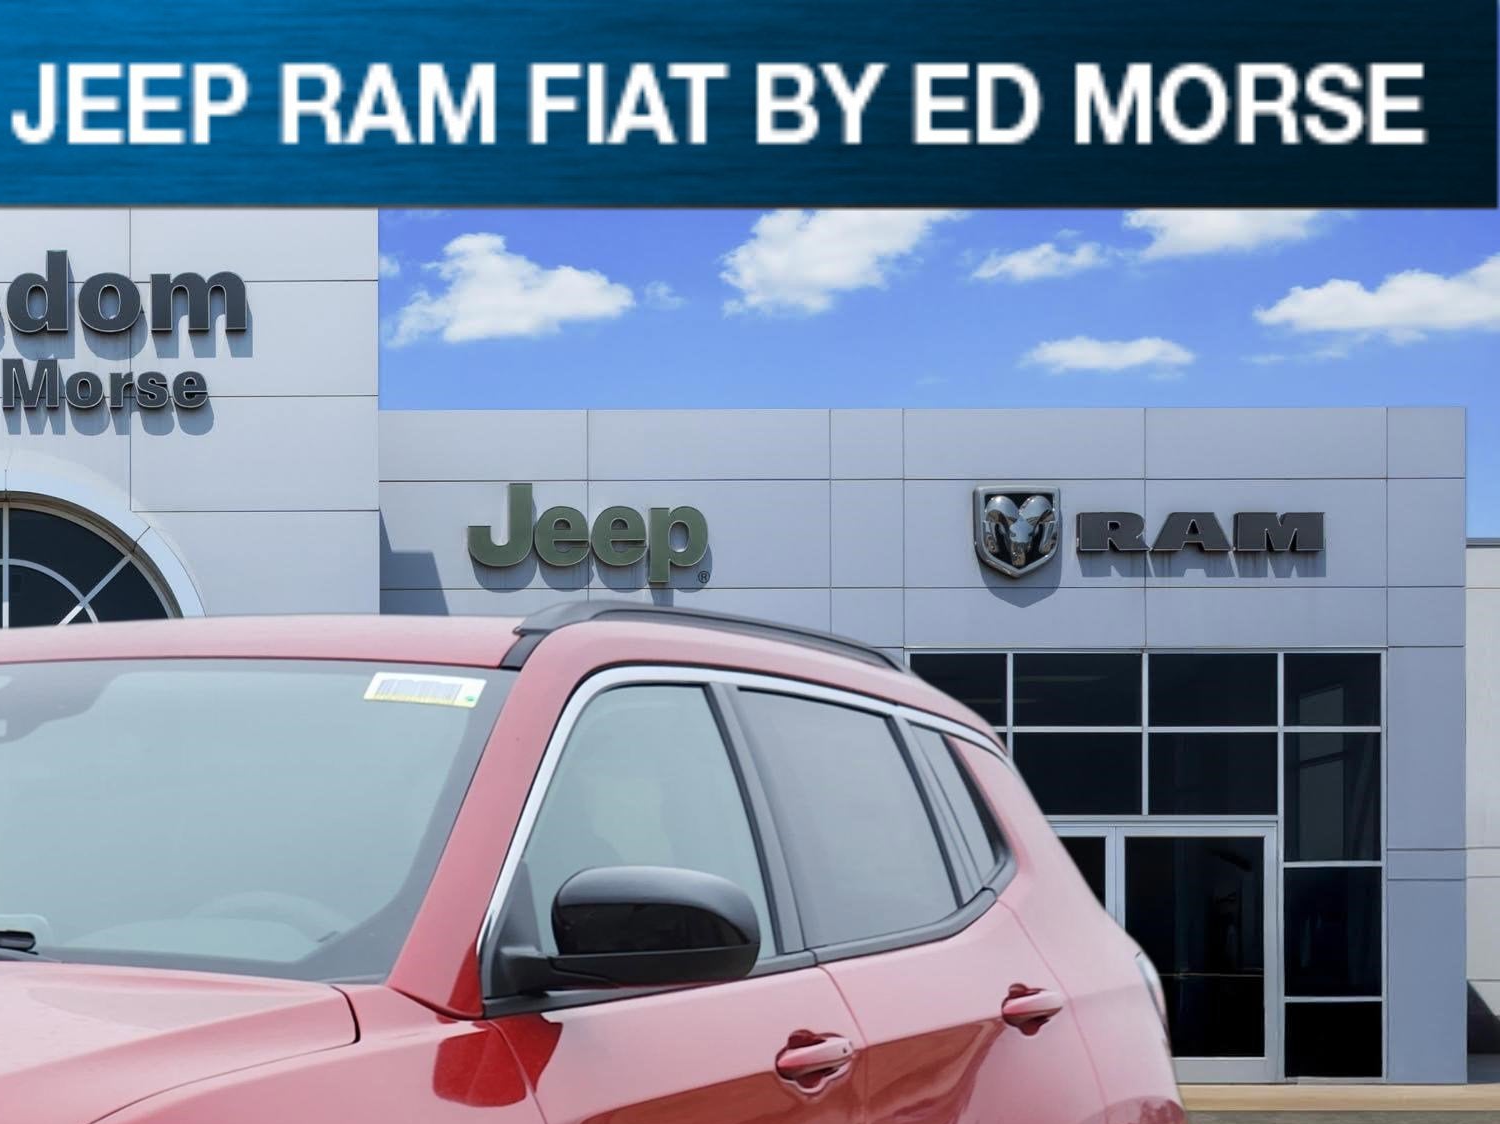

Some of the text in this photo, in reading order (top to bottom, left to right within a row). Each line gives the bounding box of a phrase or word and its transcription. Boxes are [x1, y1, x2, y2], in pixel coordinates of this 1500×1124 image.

[2, 358, 209, 409] Morse
[467, 483, 709, 584] Jeep
[1076, 511, 1326, 553] RAM
